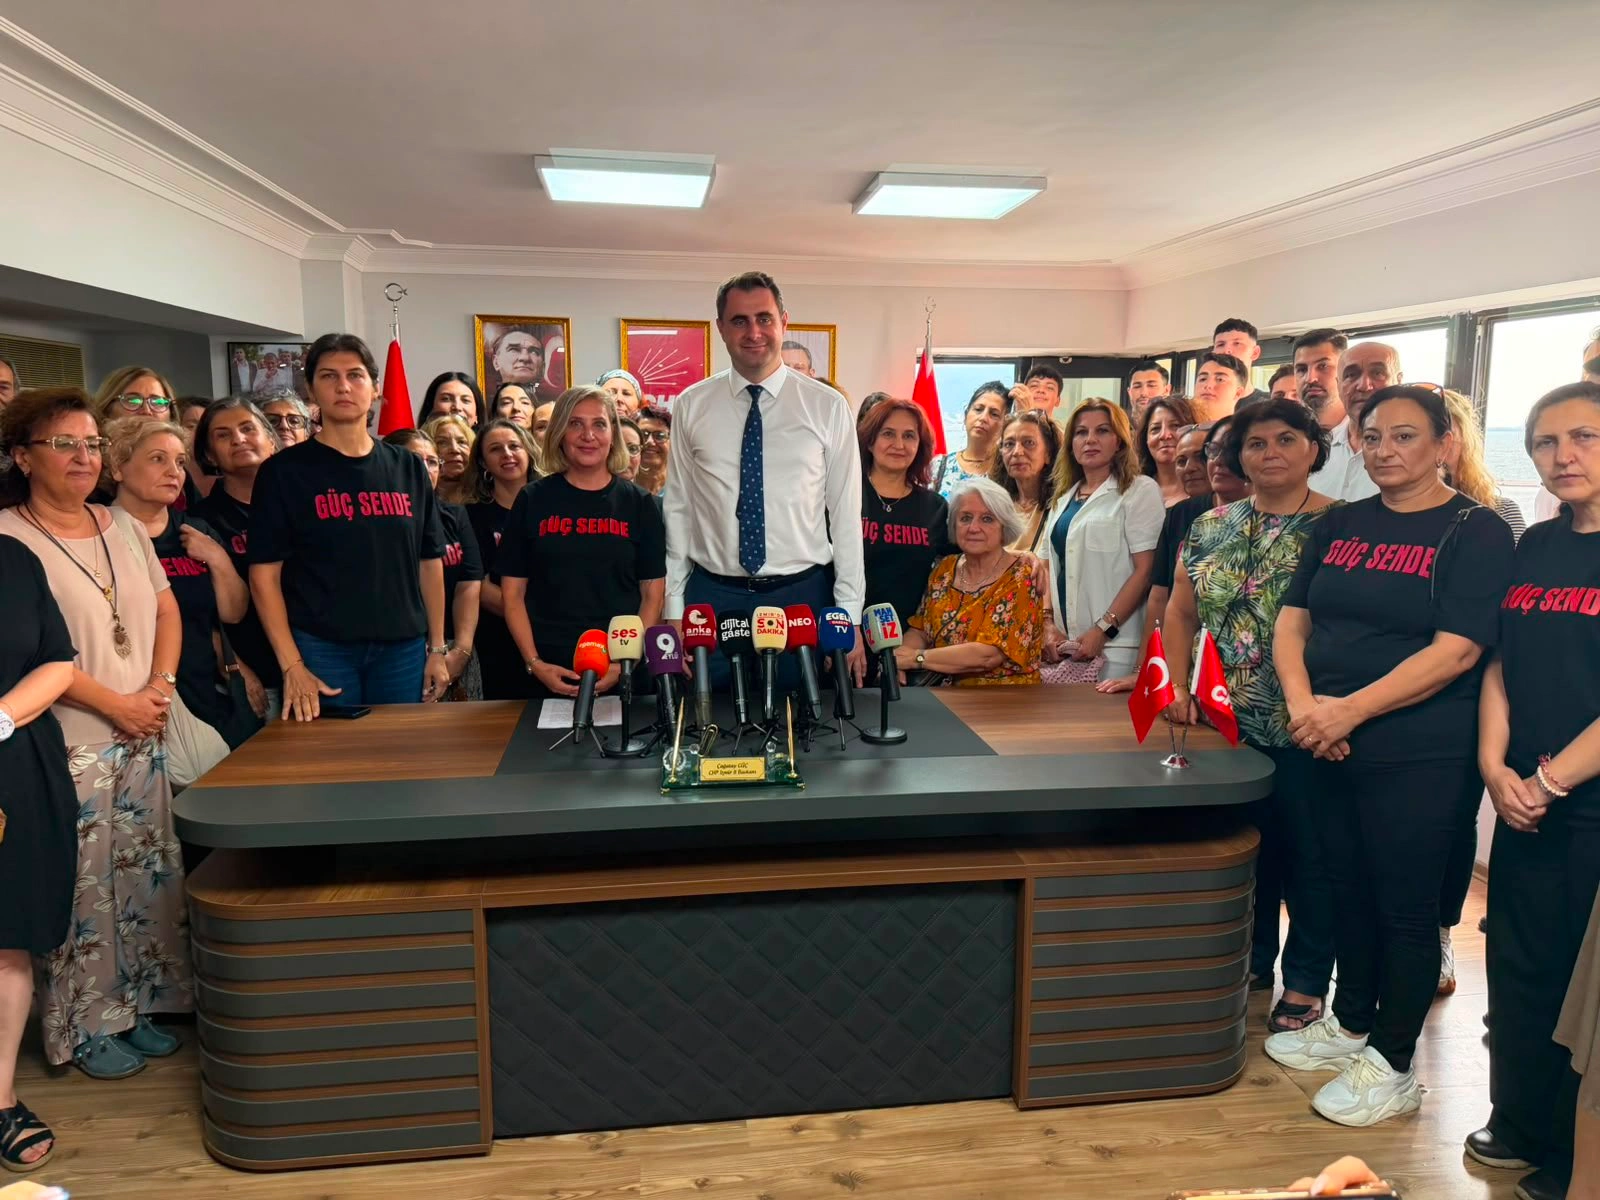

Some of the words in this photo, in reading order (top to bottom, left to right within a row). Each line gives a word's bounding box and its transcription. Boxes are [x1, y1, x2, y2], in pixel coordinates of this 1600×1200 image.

[314, 488, 354, 521] GÜÇ
[358, 491, 413, 517] SENDE
[576, 517, 630, 538] SENDE
[862, 516, 879, 545] ÜÇ
[883, 523, 929, 546] SENDE
[1322, 536, 1370, 572] GÜÇ
[1365, 543, 1436, 578] SENDE
[1539, 587, 1600, 616] SEND
[720, 618, 750, 631] dijital
[788, 617, 812, 628] NEO
[611, 628, 638, 639] ses
[686, 625, 712, 634] anka
[834, 625, 848, 634] TV
[619, 638, 630, 646] tv
